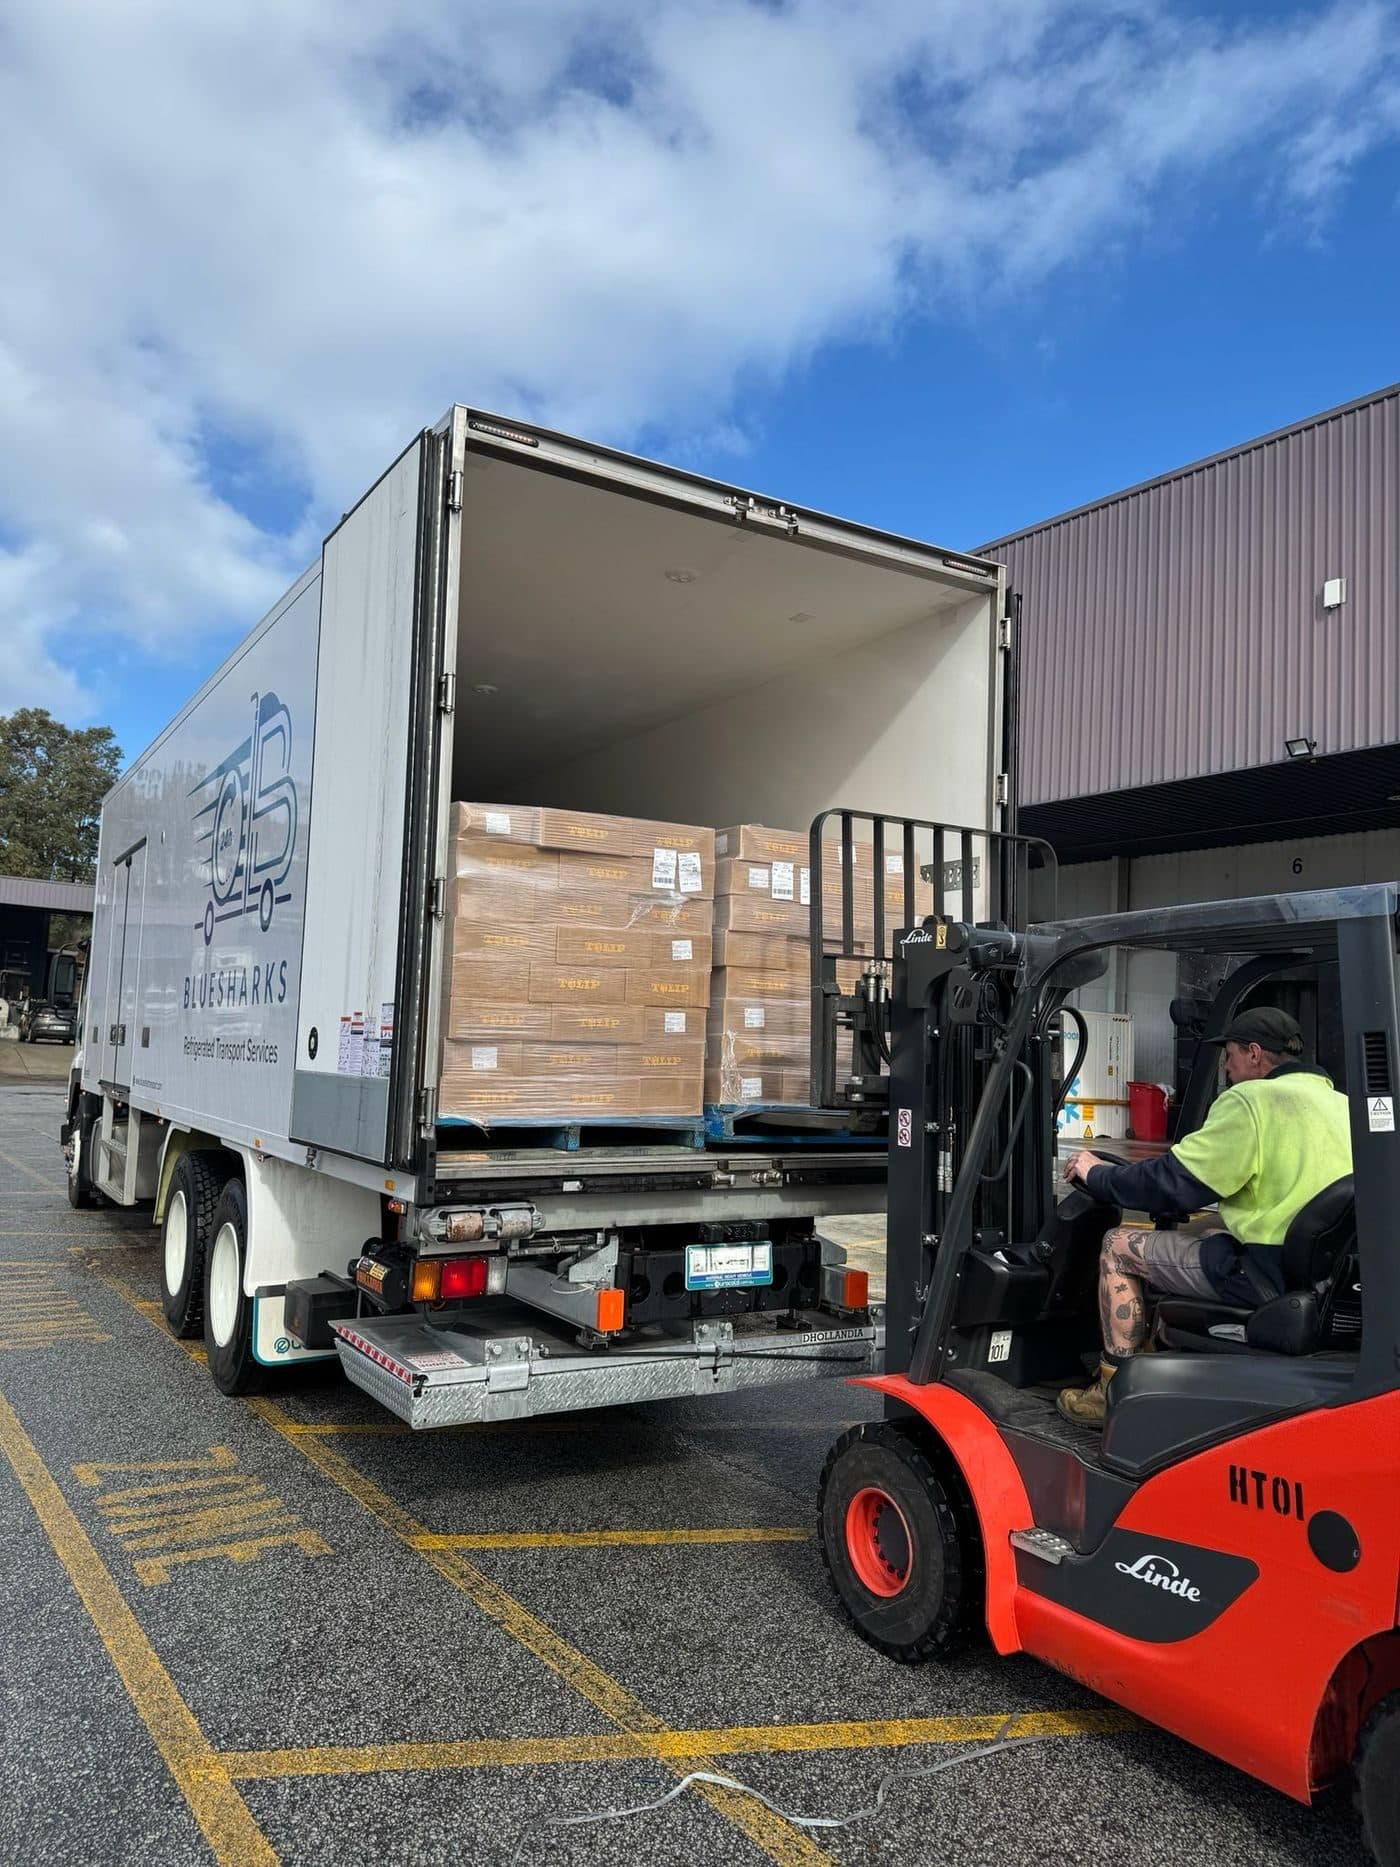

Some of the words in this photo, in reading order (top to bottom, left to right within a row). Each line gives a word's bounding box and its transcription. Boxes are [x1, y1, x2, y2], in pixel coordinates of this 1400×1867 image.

[1292, 857, 1303, 874] 6
[900, 928, 933, 944] Linde
[183, 959, 287, 1009] BLUESHARKS
[184, 1036, 215, 1061] Refrigerated
[216, 1037, 246, 1064] Transport
[246, 1038, 278, 1064] Services
[803, 1328, 864, 1343] DHOLLANDIA
[71, 1445, 334, 1587] ZONE
[1114, 1554, 1201, 1602] Linde
